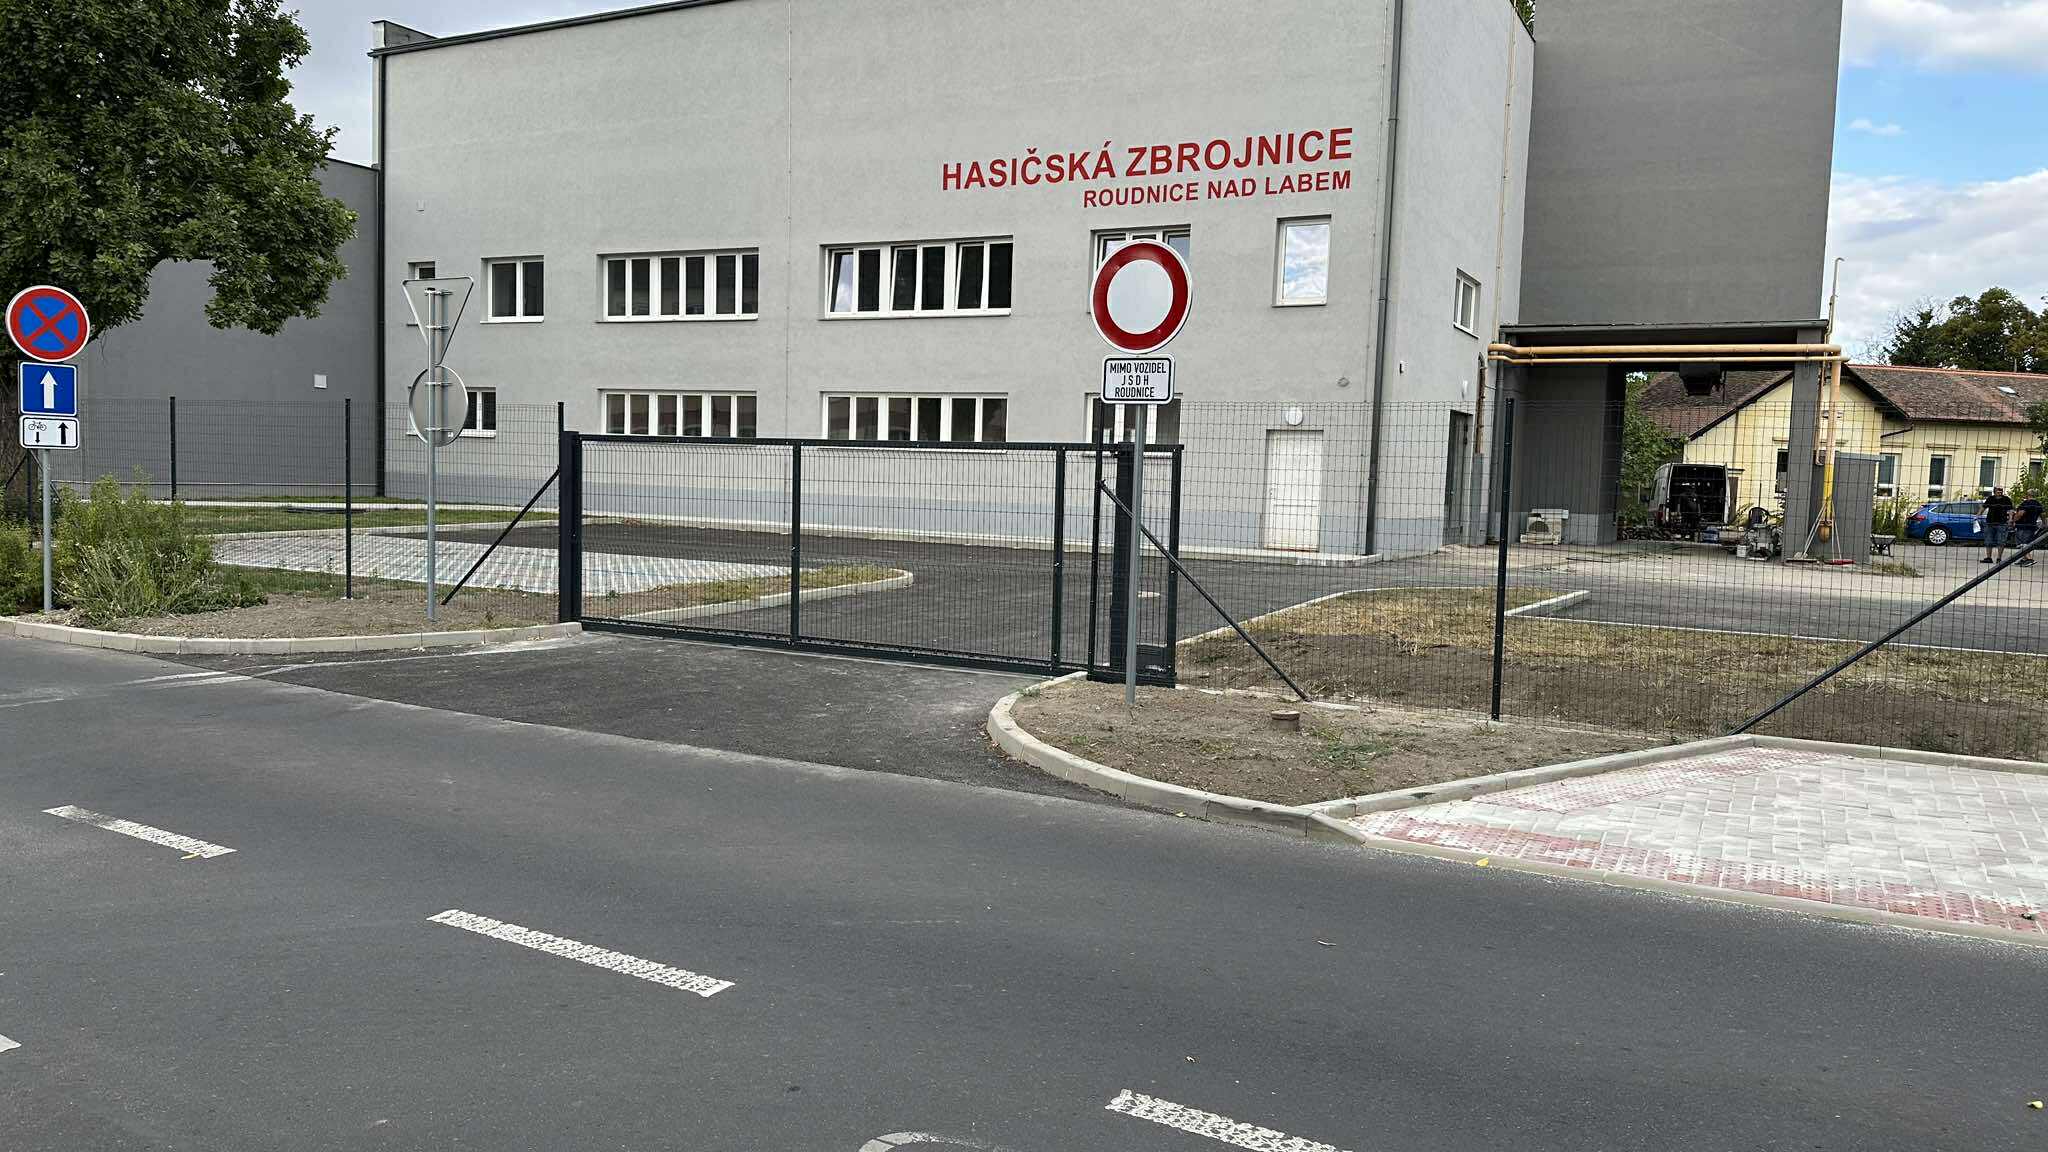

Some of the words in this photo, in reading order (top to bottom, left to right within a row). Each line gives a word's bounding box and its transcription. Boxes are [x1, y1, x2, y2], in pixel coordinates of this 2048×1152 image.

[942, 141, 1116, 191] HASIČSKÁ
[1125, 127, 1353, 177] ZBROJNICE
[1084, 182, 1200, 208] ROUDNICE
[1207, 176, 1257, 200] NAD
[1265, 169, 1351, 196] LABEM
[1110, 363, 1132, 373] MIMO
[1134, 362, 1166, 373] VOZIDEL
[1115, 387, 1154, 397] ROUDNICE
